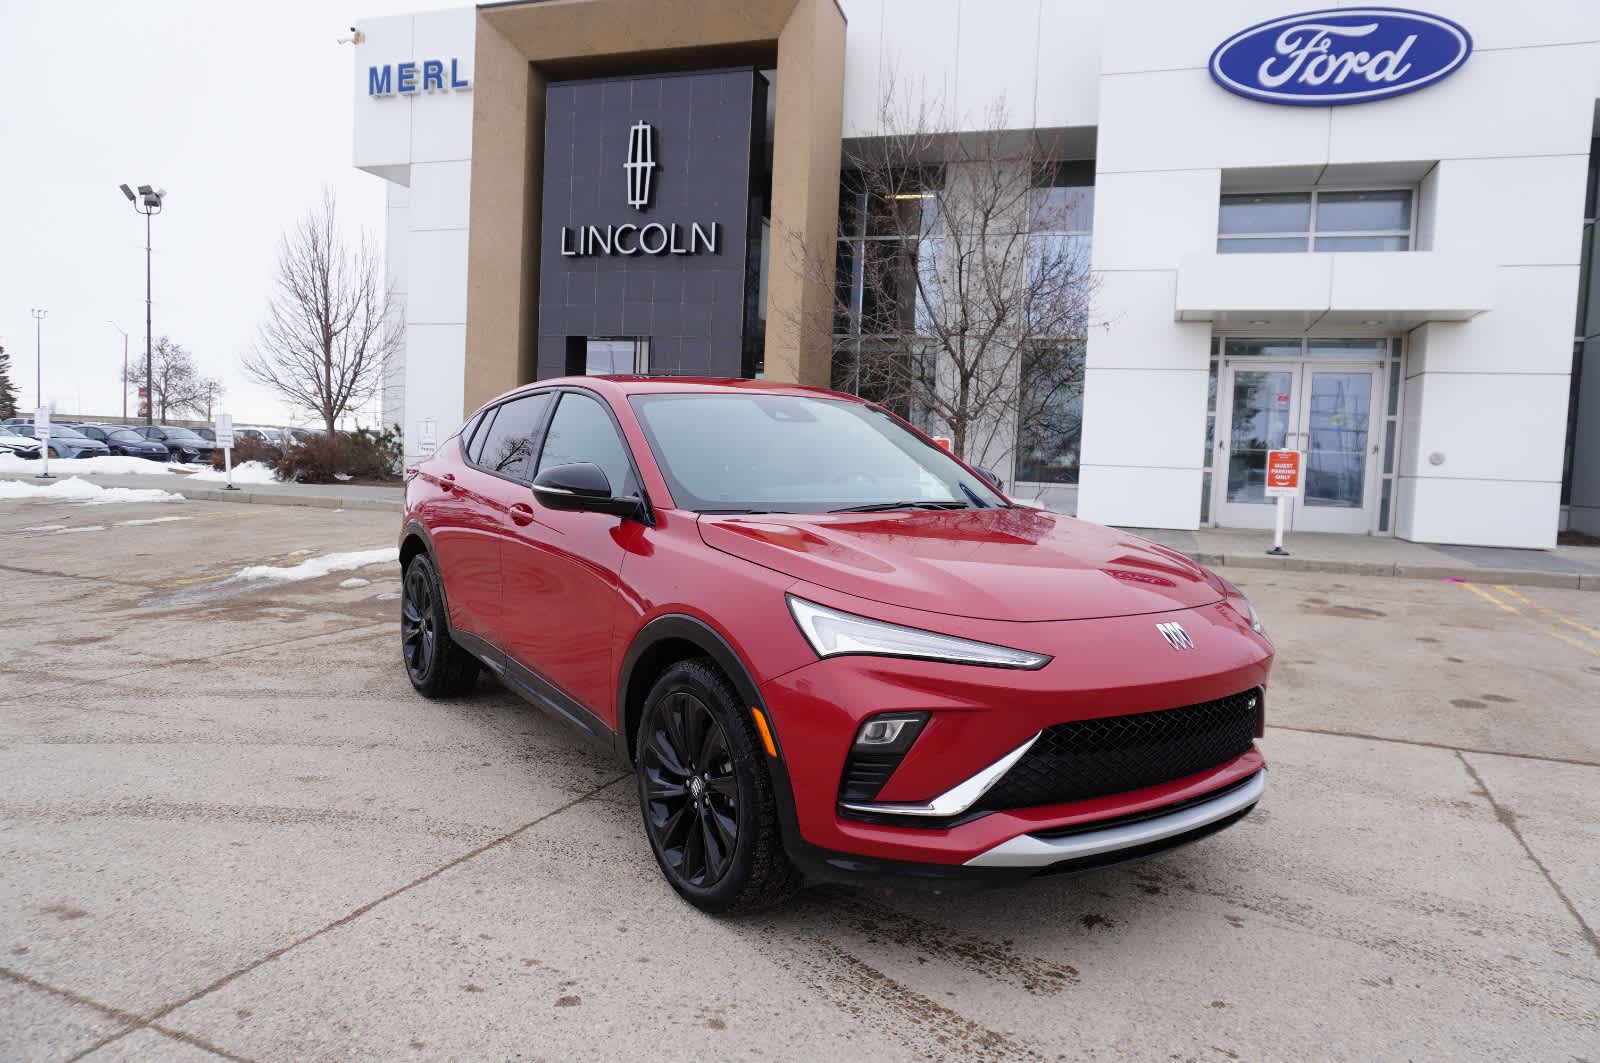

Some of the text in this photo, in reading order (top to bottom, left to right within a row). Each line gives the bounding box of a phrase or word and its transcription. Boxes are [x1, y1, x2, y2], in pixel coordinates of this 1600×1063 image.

[1257, 22, 1419, 88] Ford
[368, 57, 470, 97] MERL
[560, 221, 718, 256] LINCOLN
